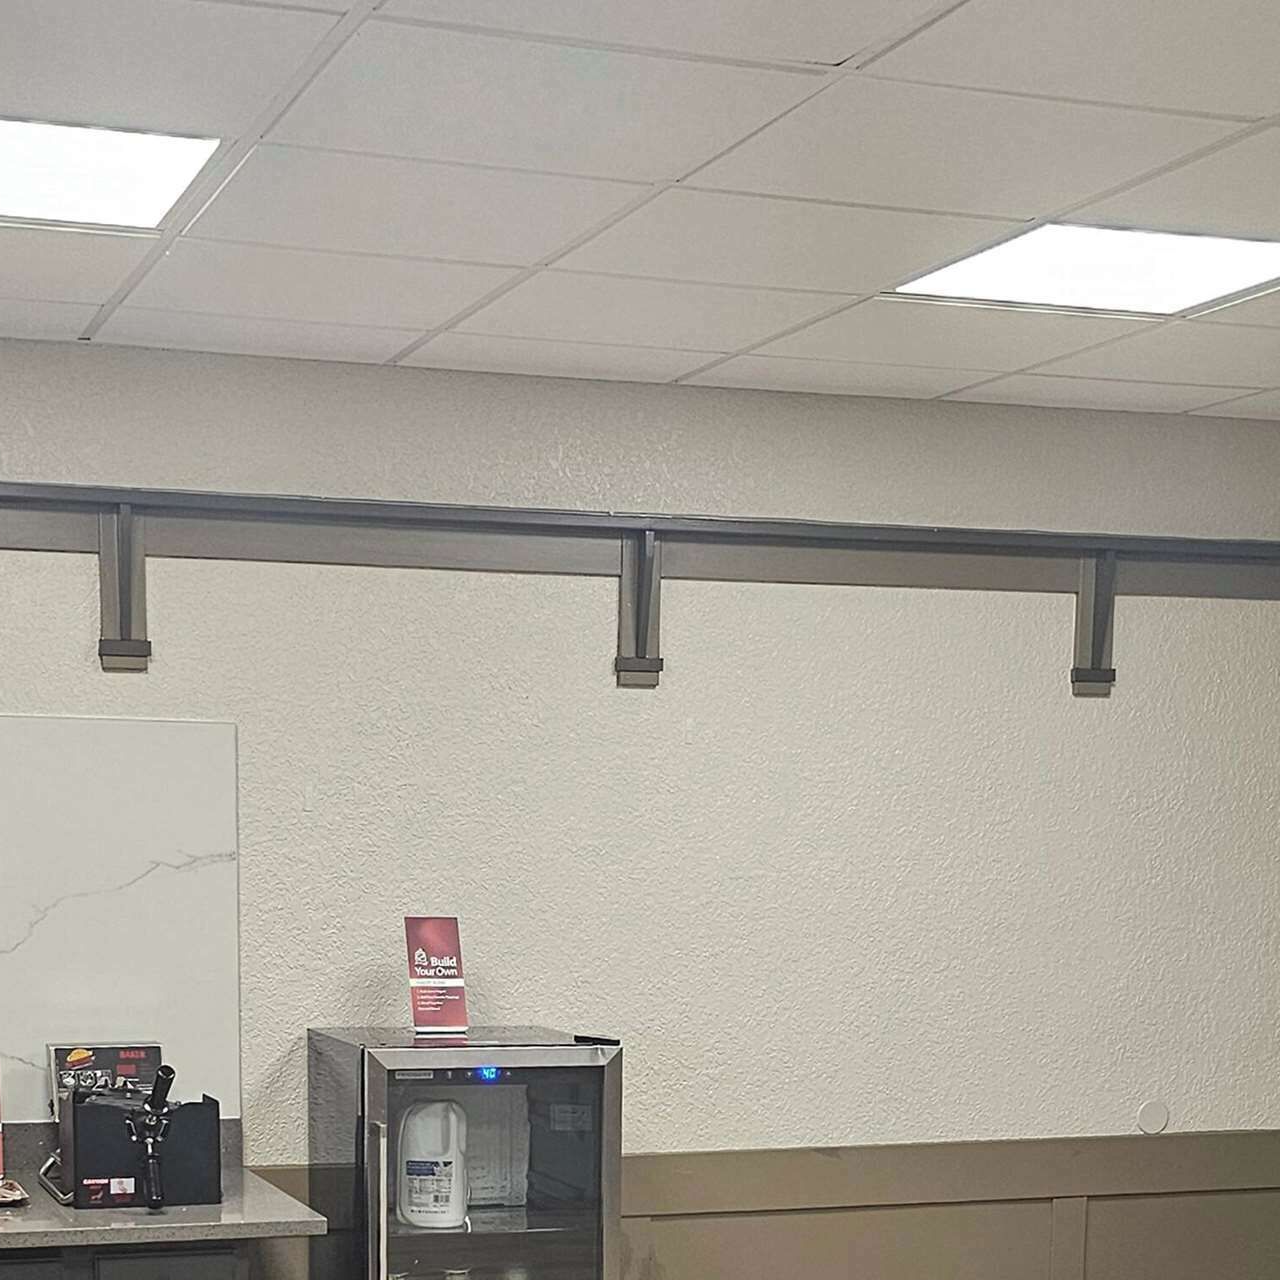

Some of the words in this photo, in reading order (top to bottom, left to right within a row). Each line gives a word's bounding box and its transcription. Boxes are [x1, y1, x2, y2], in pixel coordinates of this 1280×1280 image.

[430, 956, 457, 967] Build
[414, 966, 435, 976] Your
[436, 966, 458, 976] Own
